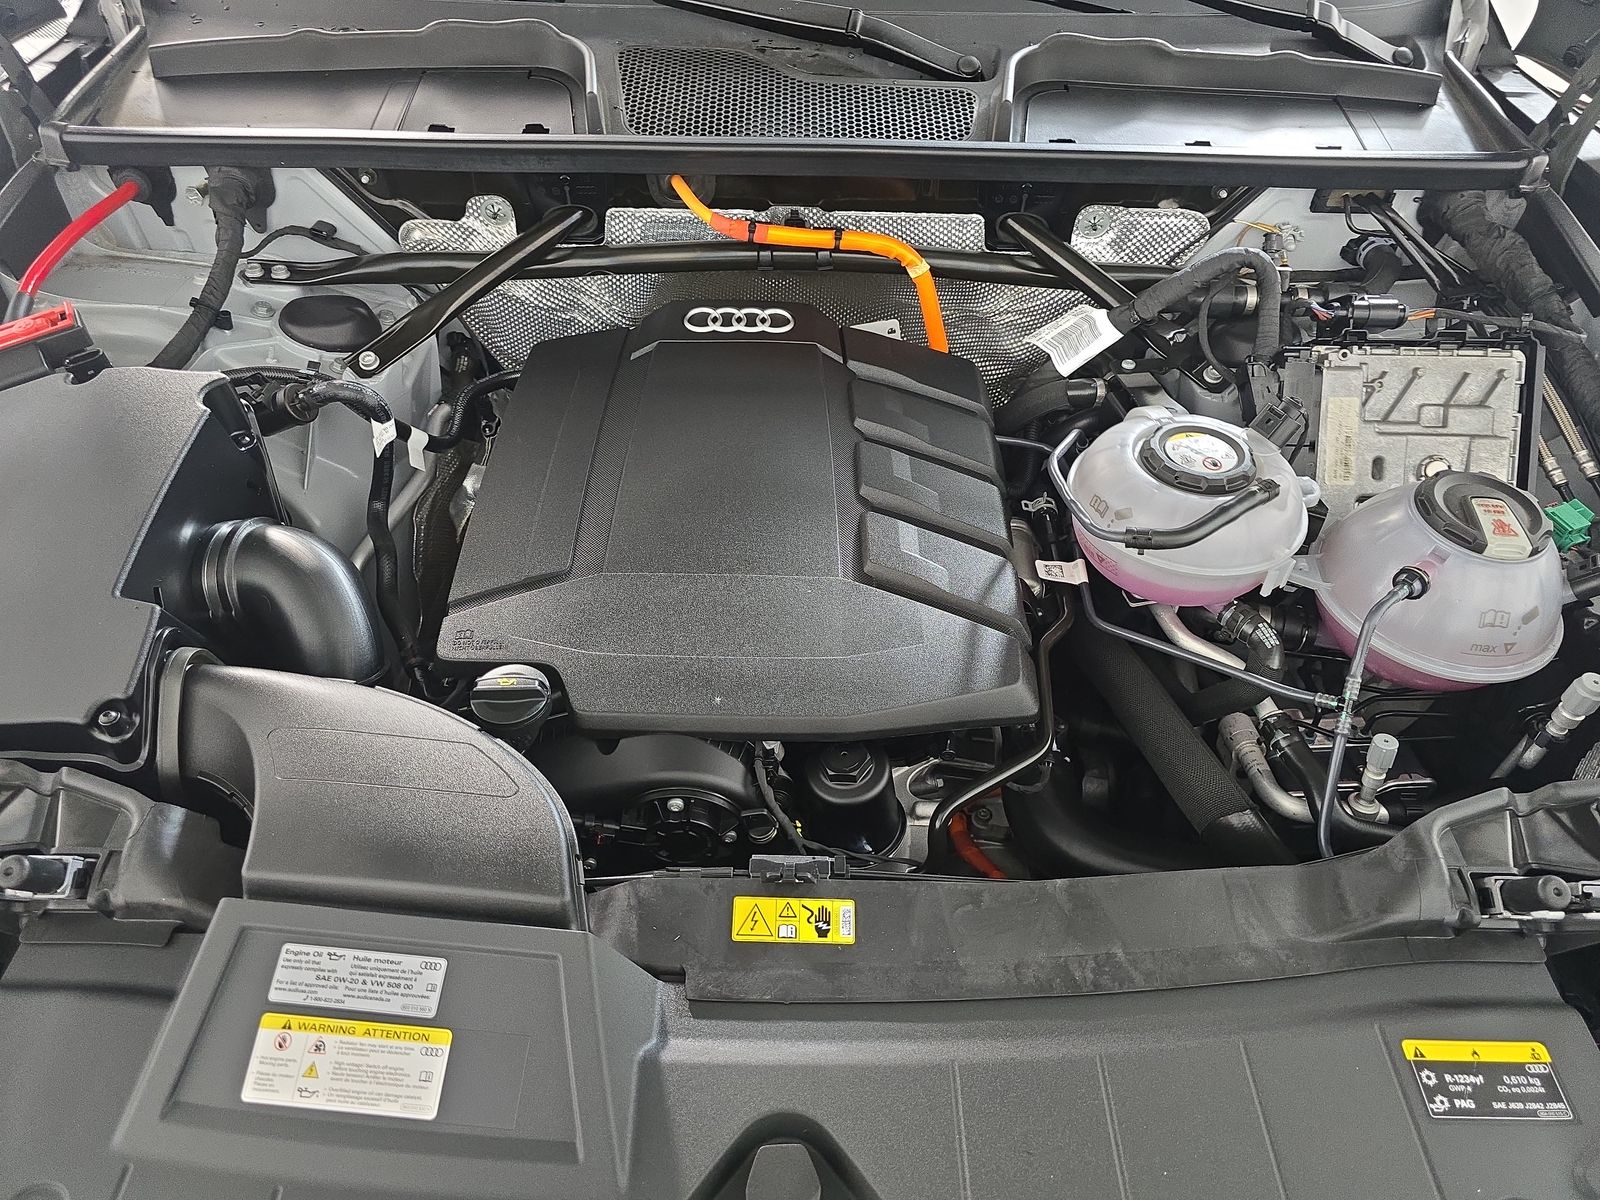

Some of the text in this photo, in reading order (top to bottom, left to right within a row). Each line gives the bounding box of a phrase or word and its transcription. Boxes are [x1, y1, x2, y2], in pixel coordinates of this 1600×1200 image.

[1470, 643, 1499, 653] max
[285, 948, 311, 956] Engine
[373, 957, 403, 966] moteur
[315, 974, 332, 982] SAE
[298, 1021, 430, 1042] WARNING ATTENTION
[1443, 1073, 1484, 1085] R-1234yf
[1527, 1075, 1541, 1086] kg
[1453, 1098, 1476, 1109] PAG
